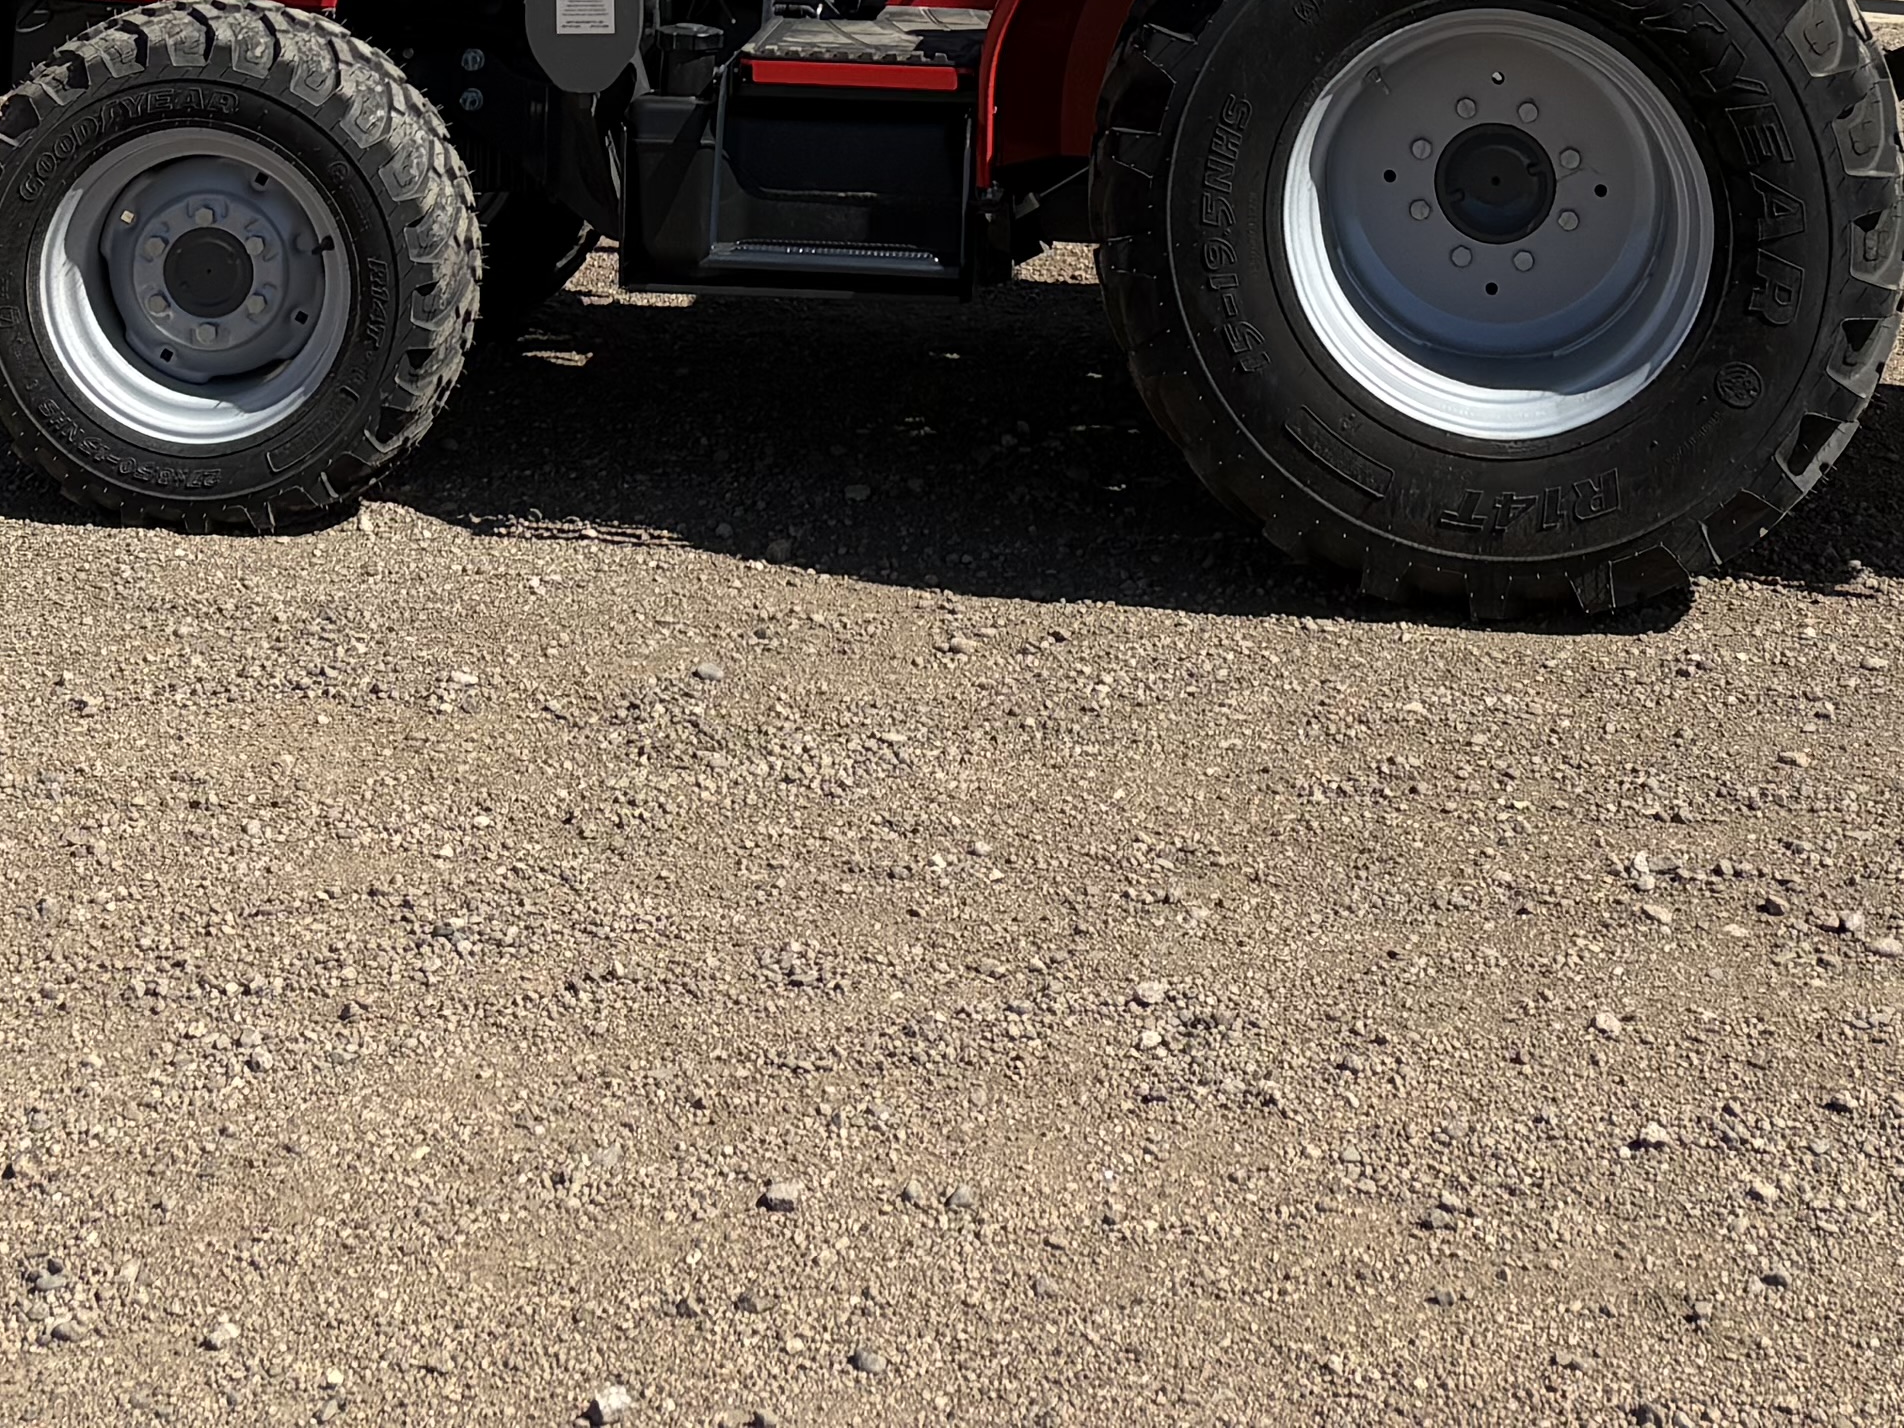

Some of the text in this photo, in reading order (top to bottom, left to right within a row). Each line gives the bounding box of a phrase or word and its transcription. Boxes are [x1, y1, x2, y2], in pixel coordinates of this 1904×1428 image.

[18, 87, 240, 202] GOODYEAR
[1198, 93, 1272, 376] 15-19.5NHS
[364, 255, 388, 350] R14T
[1440, 468, 1621, 535] R14T
